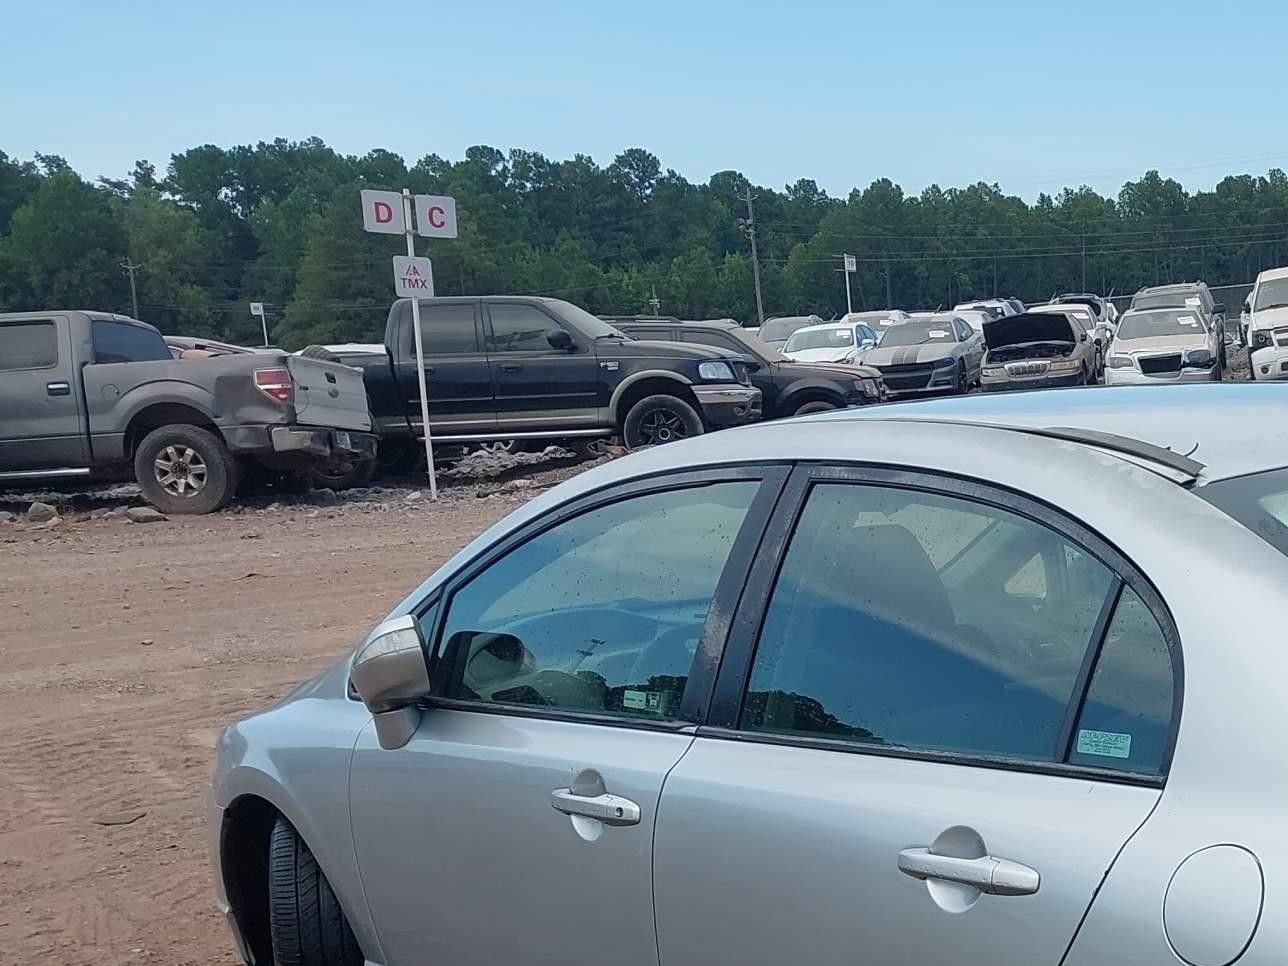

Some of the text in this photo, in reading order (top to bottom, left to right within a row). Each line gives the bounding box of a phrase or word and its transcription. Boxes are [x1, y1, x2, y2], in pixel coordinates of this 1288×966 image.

[374, 201, 393, 224] D
[427, 206, 446, 228] C
[400, 277, 429, 290] TMX
